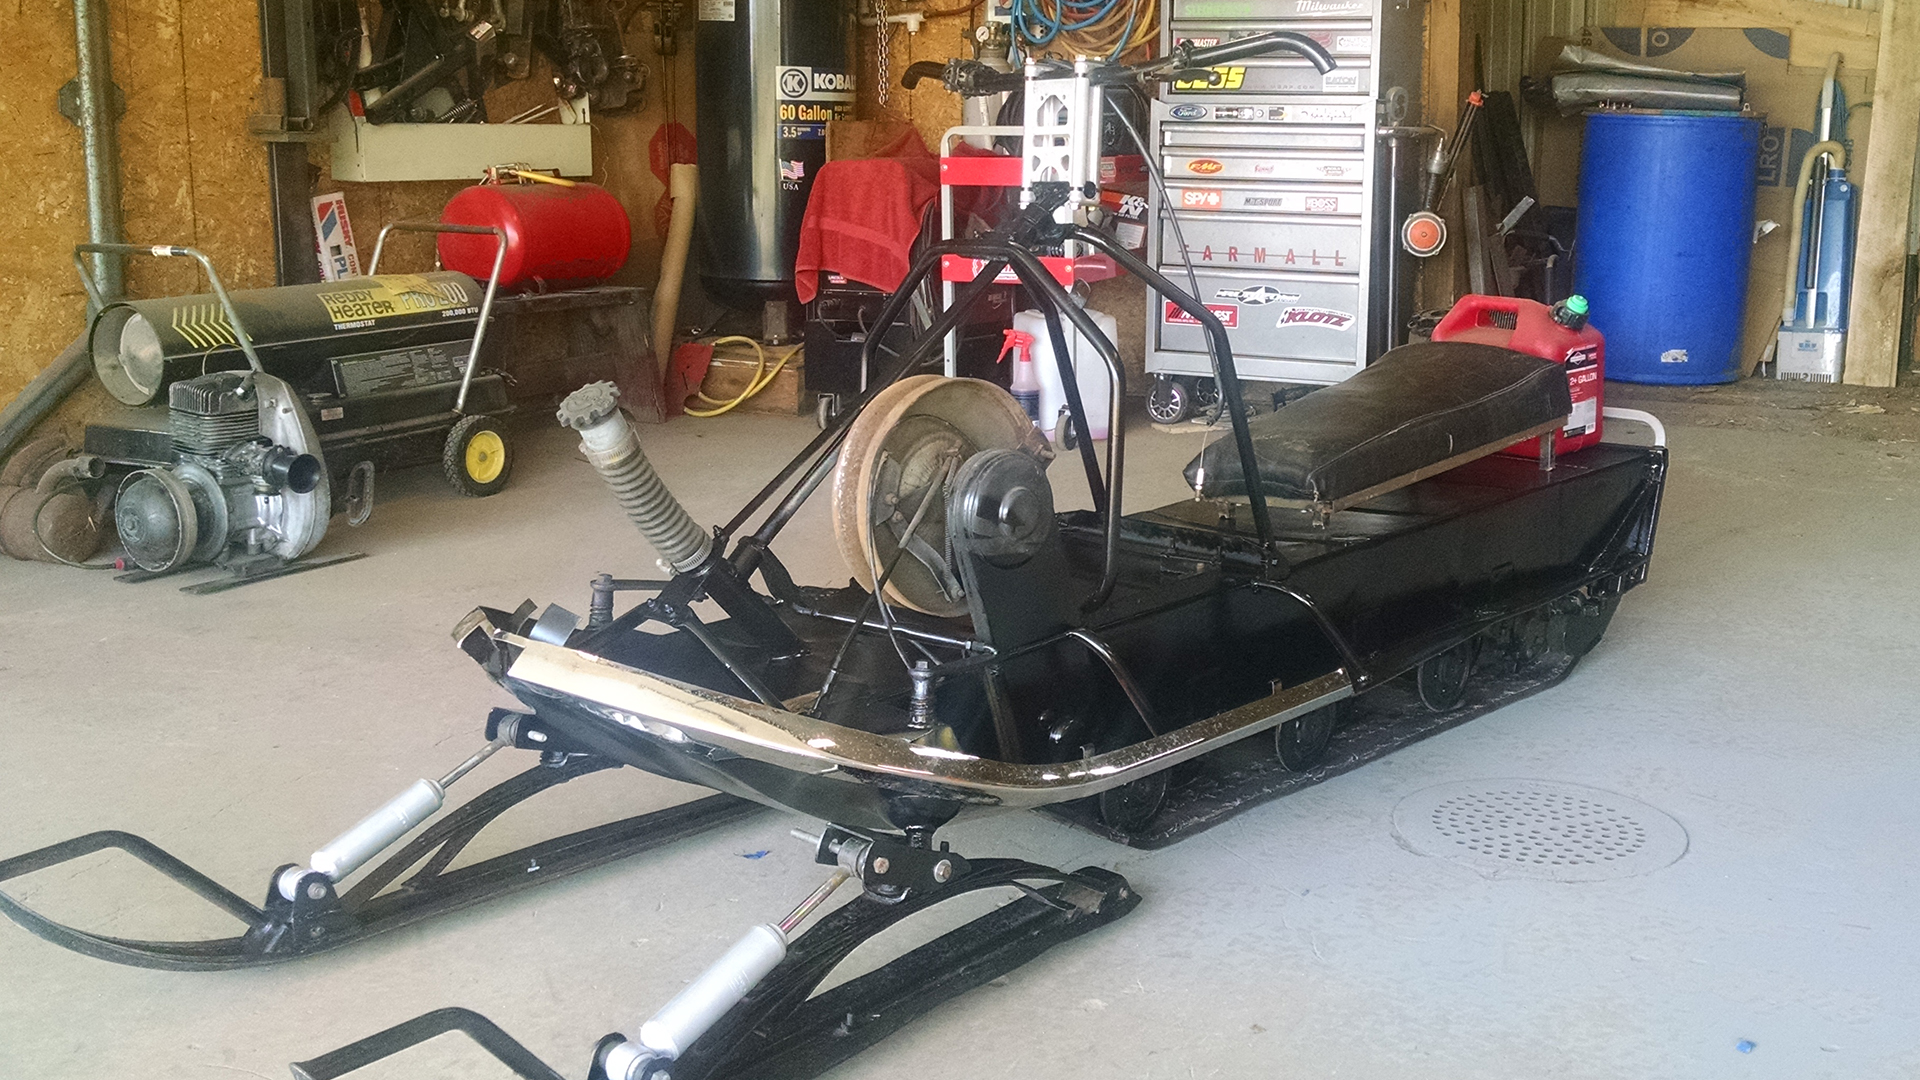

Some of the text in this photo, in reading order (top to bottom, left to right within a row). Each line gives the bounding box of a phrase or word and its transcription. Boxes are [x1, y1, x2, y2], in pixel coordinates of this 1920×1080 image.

[813, 73, 856, 91] KOBAL
[779, 104, 796, 121] 60
[798, 104, 833, 121] Gallon
[782, 126, 797, 138] 3.5
[1184, 192, 1208, 205] SPY
[333, 319, 376, 331] THERMOSTAT
[1284, 311, 1351, 327] KLOTZ
[1578, 372, 1597, 384] GALLON
